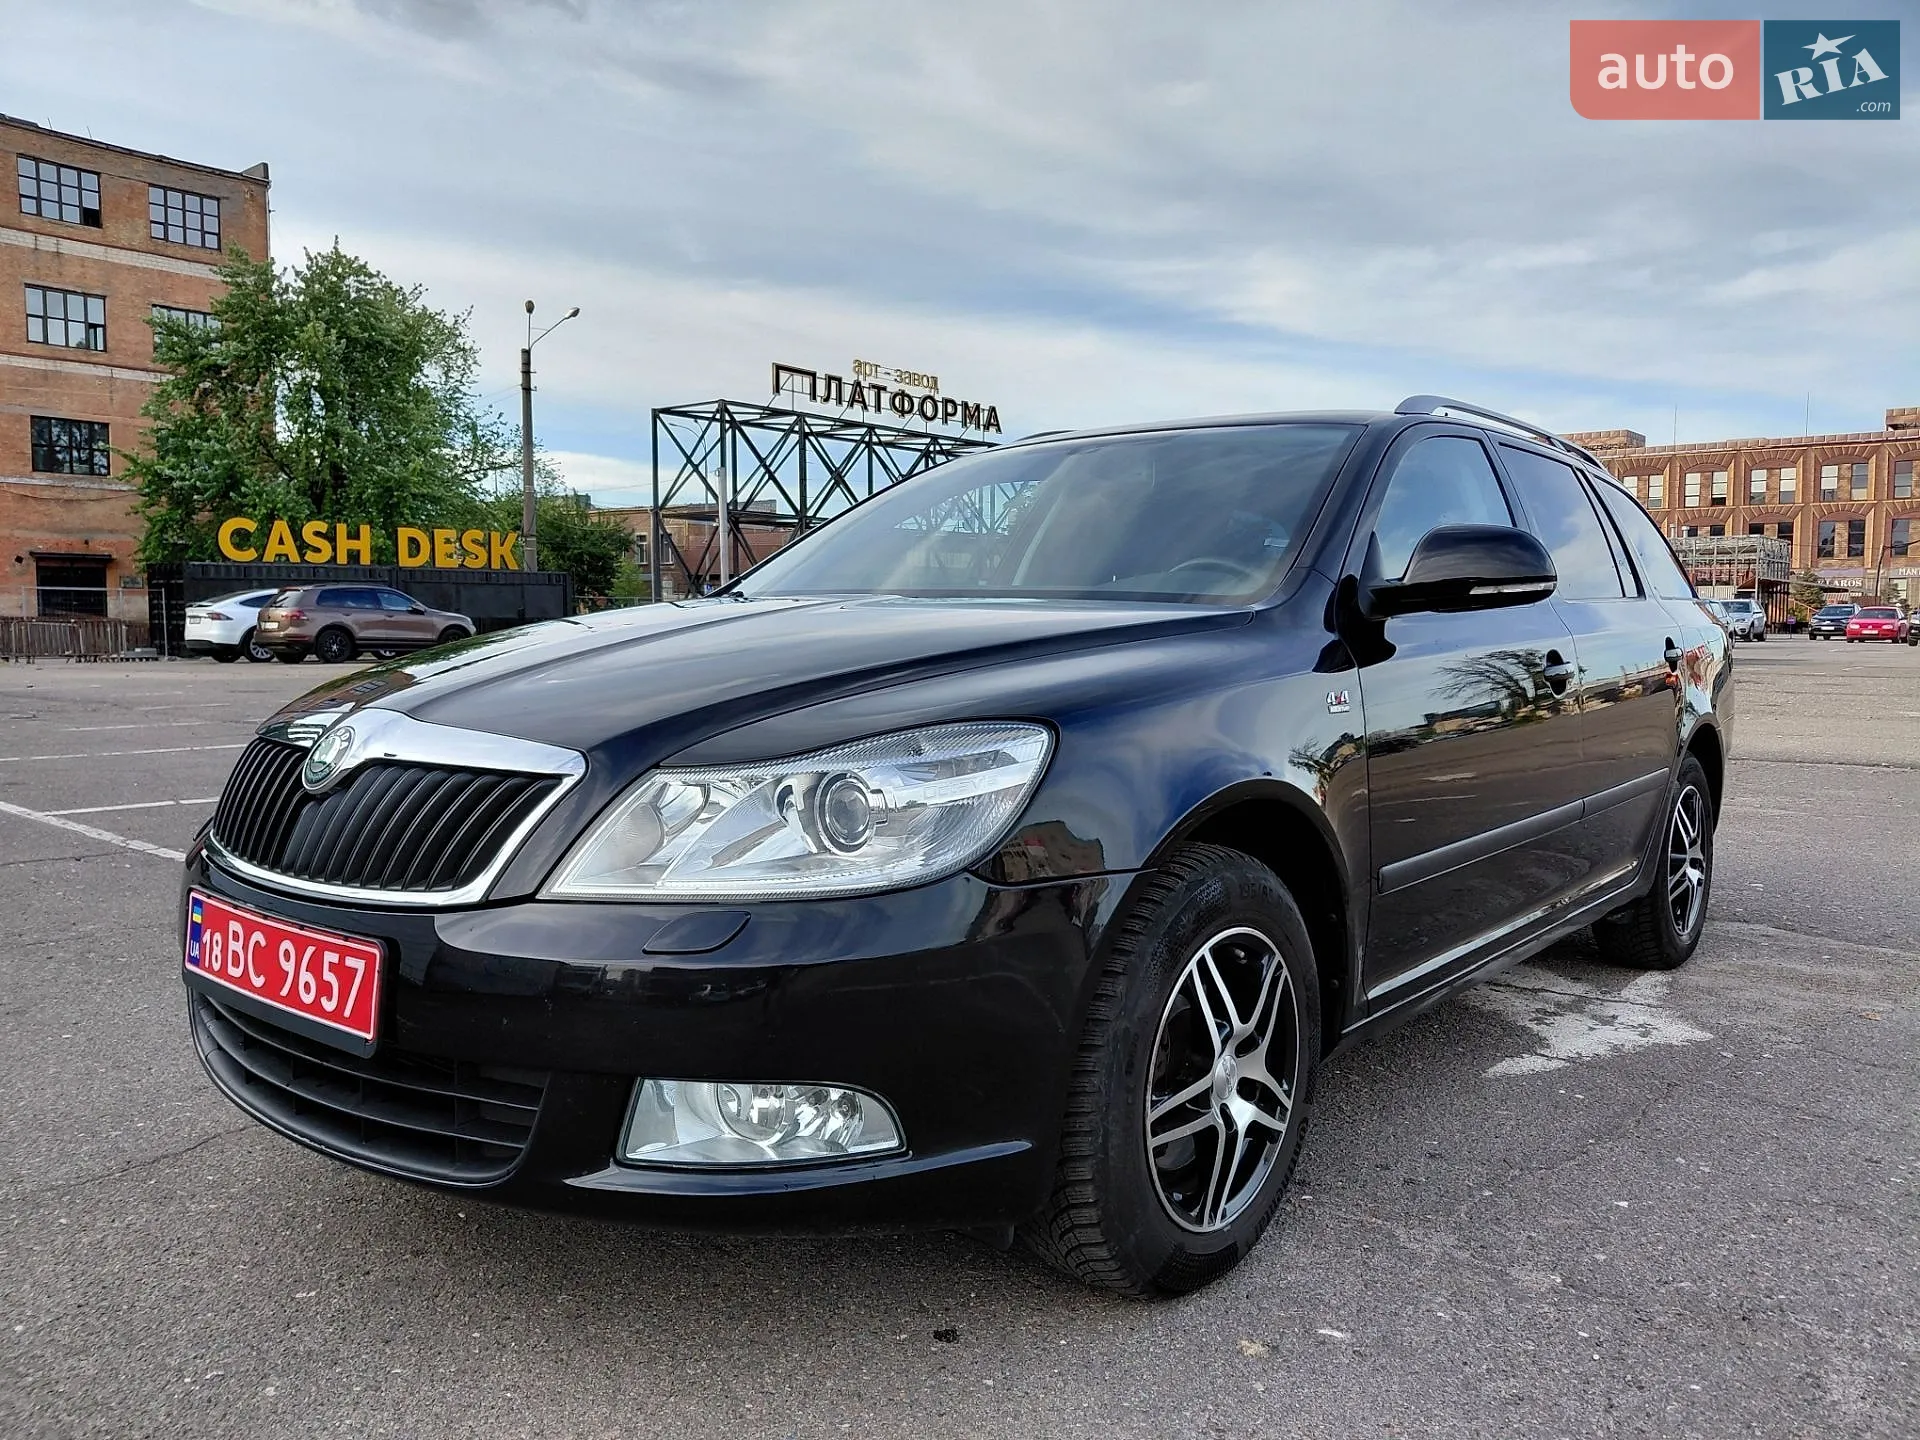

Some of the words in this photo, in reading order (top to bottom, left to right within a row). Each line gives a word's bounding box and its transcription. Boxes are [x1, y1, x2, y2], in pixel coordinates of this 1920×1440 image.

[771, 361, 1003, 435] ПЛАТФОРМА
[217, 516, 372, 566] CASH
[396, 526, 521, 571] DESK
[189, 939, 200, 960] UA
[278, 939, 367, 1019] 9657
